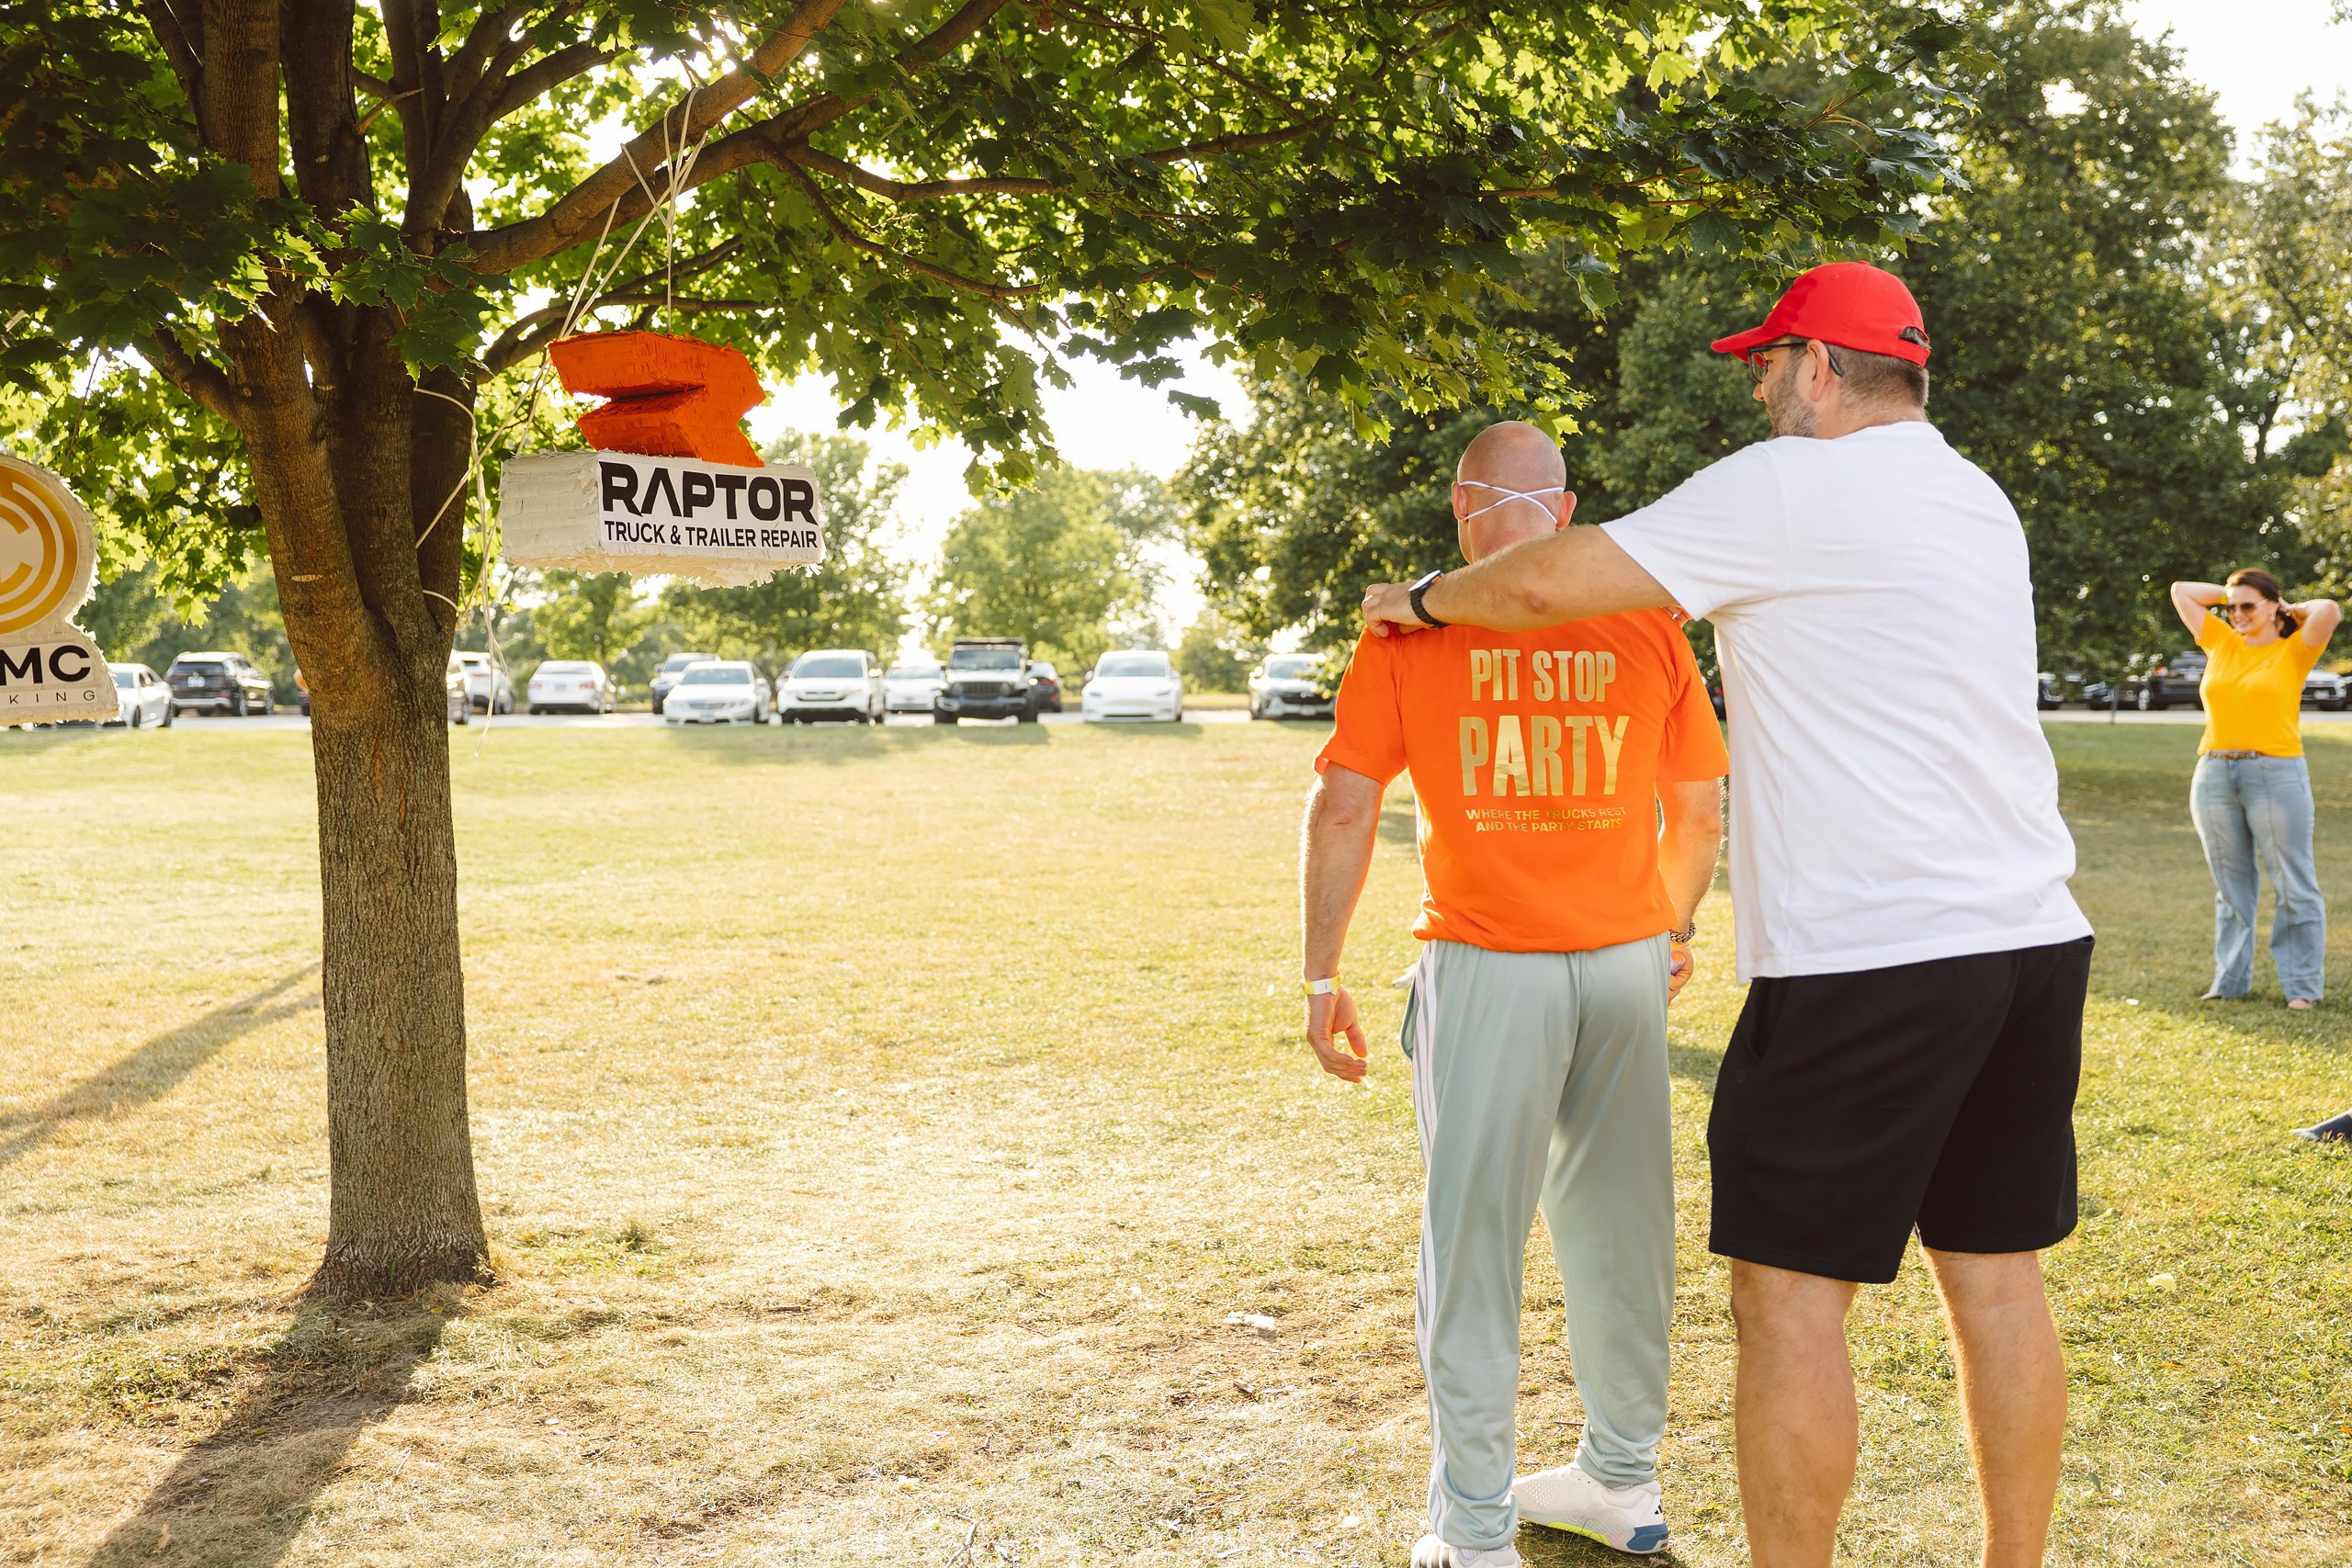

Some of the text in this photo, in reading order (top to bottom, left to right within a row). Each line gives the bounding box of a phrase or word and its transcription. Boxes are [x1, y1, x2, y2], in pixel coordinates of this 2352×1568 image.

[598, 460, 819, 525] RAPTOR
[604, 520, 819, 548] TRUCK & TRAILER REPAIR
[1470, 649, 1616, 703] PIT STOP
[1458, 715, 1631, 796] PARTY
[1464, 806, 1627, 820] WHERE THE TRUCKS REST
[1476, 818, 1623, 832] AND THE PARTY STARTS
